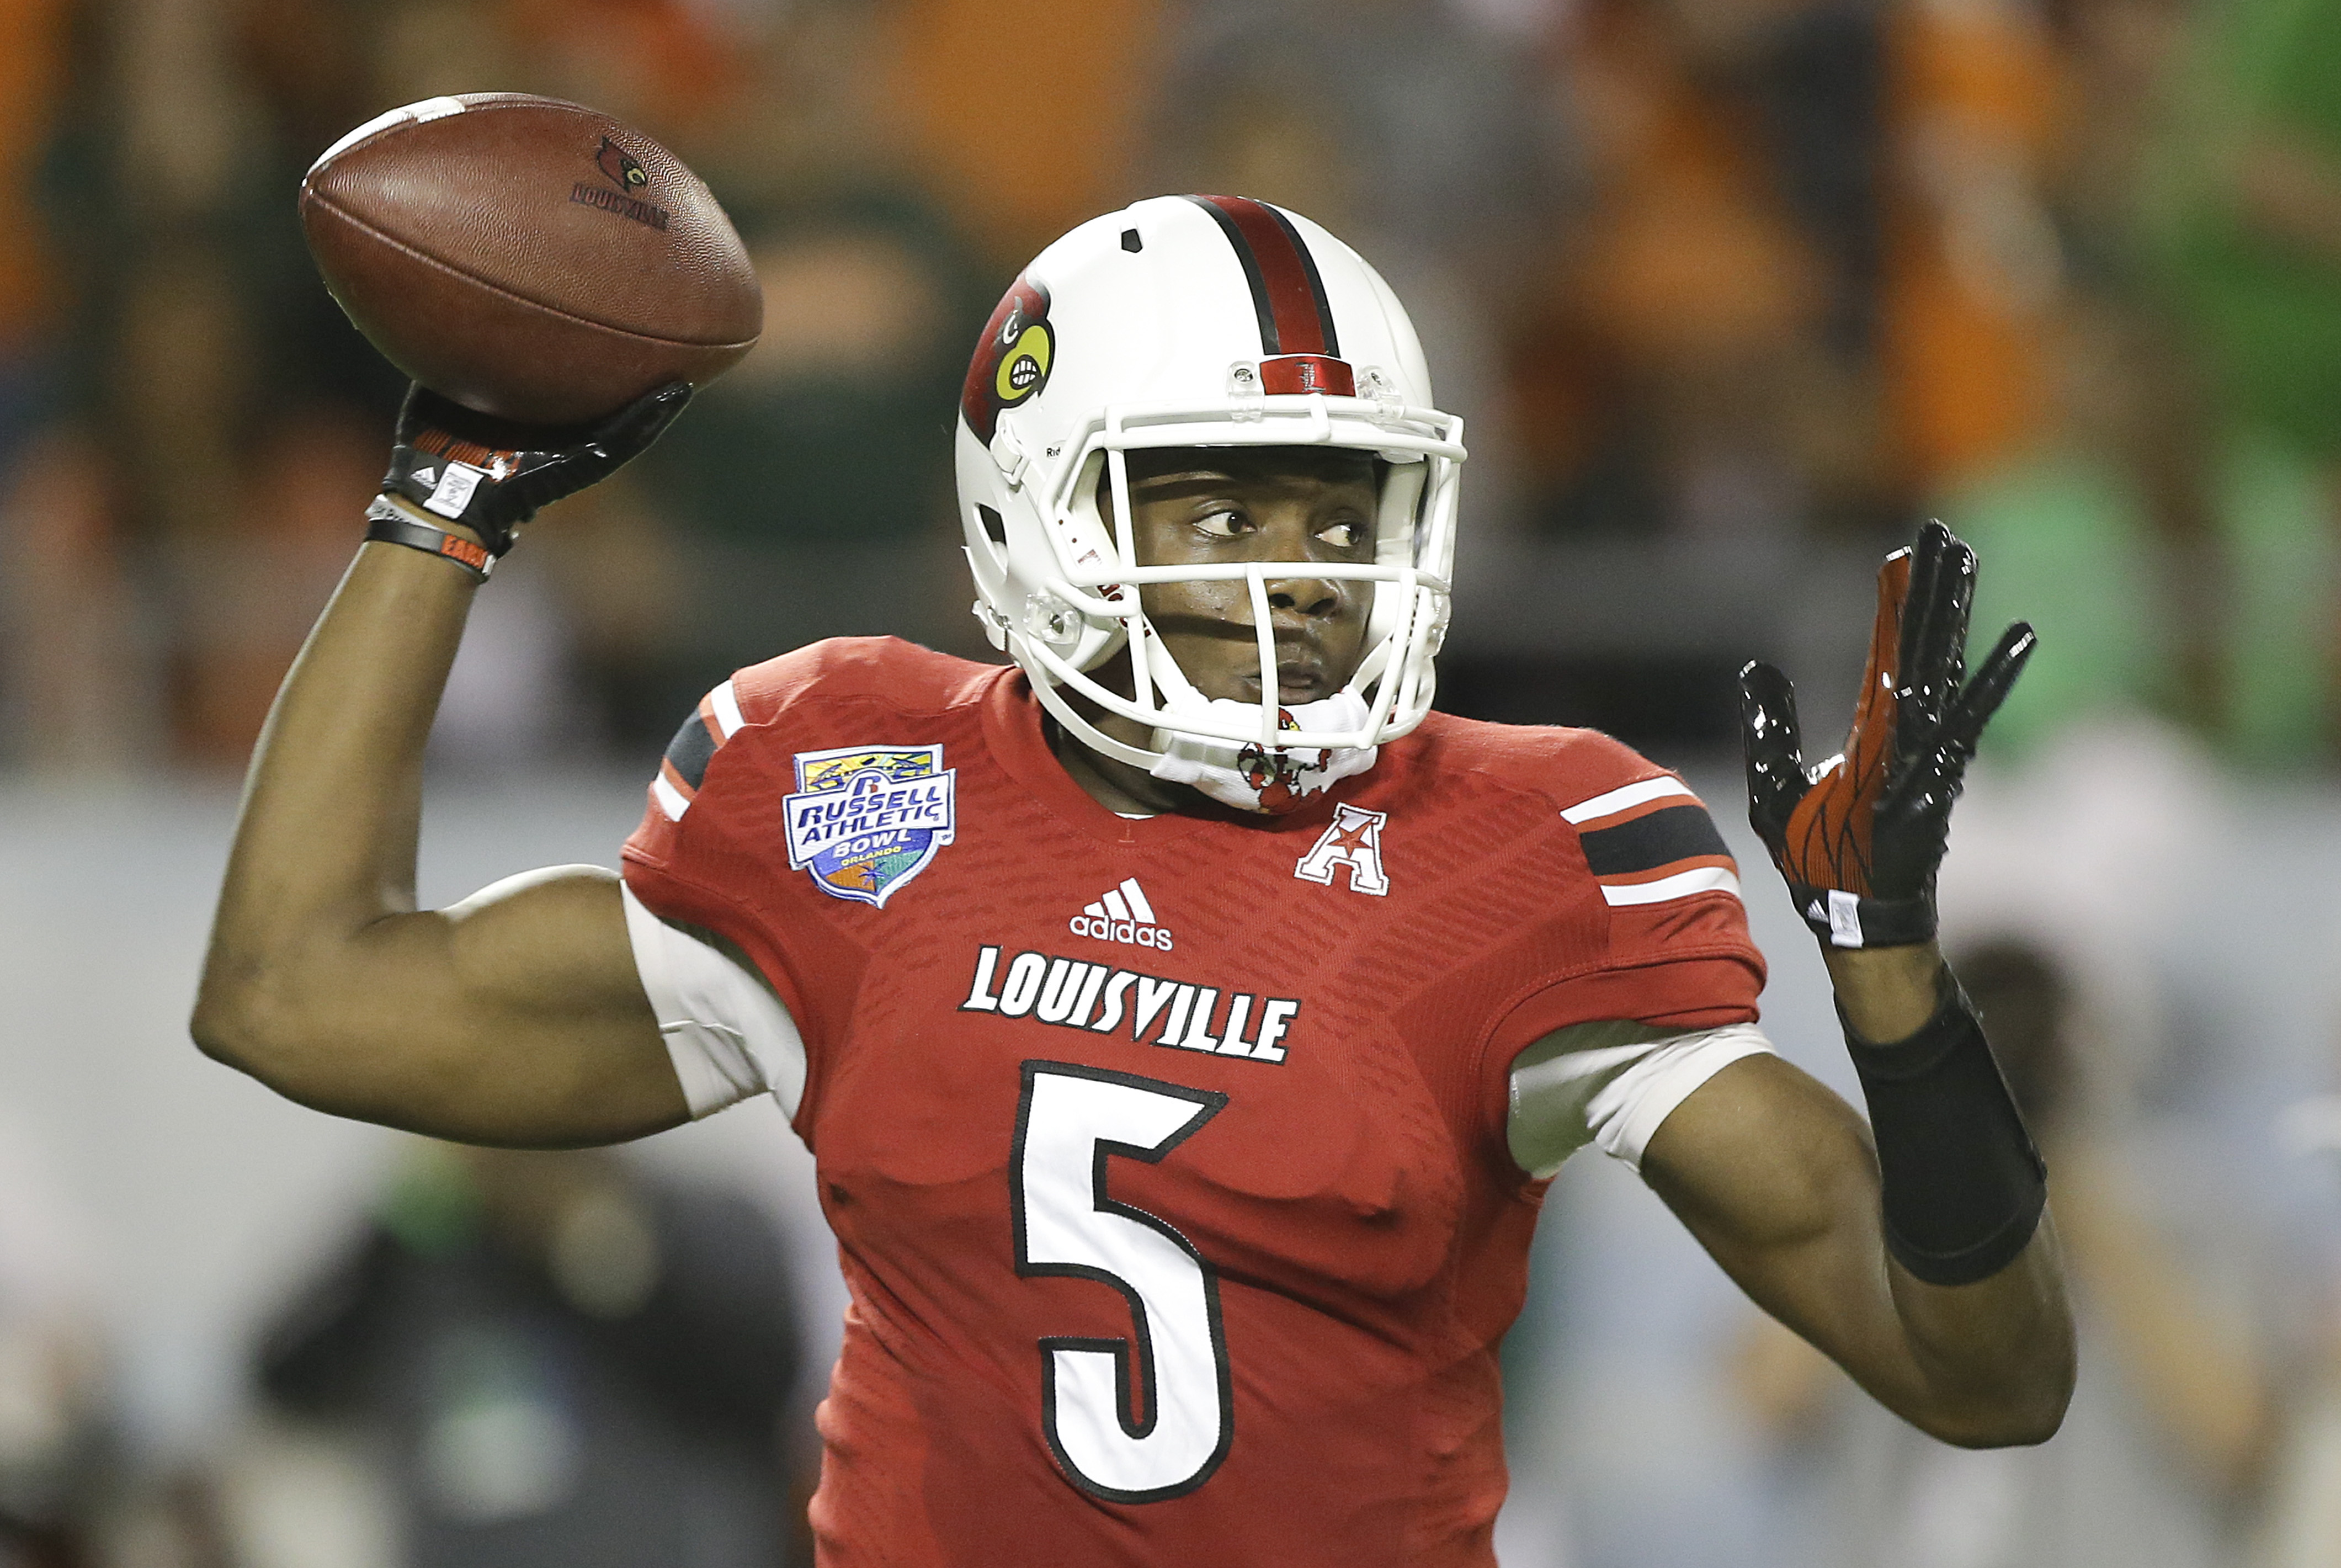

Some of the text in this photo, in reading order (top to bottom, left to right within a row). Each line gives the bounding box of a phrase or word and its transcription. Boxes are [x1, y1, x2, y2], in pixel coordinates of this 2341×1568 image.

[569, 183, 669, 231] LOUISVILLE
[798, 786, 943, 828] RUSSELL
[802, 802, 944, 845] ATHLETIC
[832, 829, 912, 858] BOWL
[840, 846, 902, 867] ORLANDO
[1294, 802, 1390, 896] A
[1069, 914, 1173, 951] adidas
[956, 944, 1301, 1065] LOUISVILLE
[1008, 1059, 1235, 1505] 5
